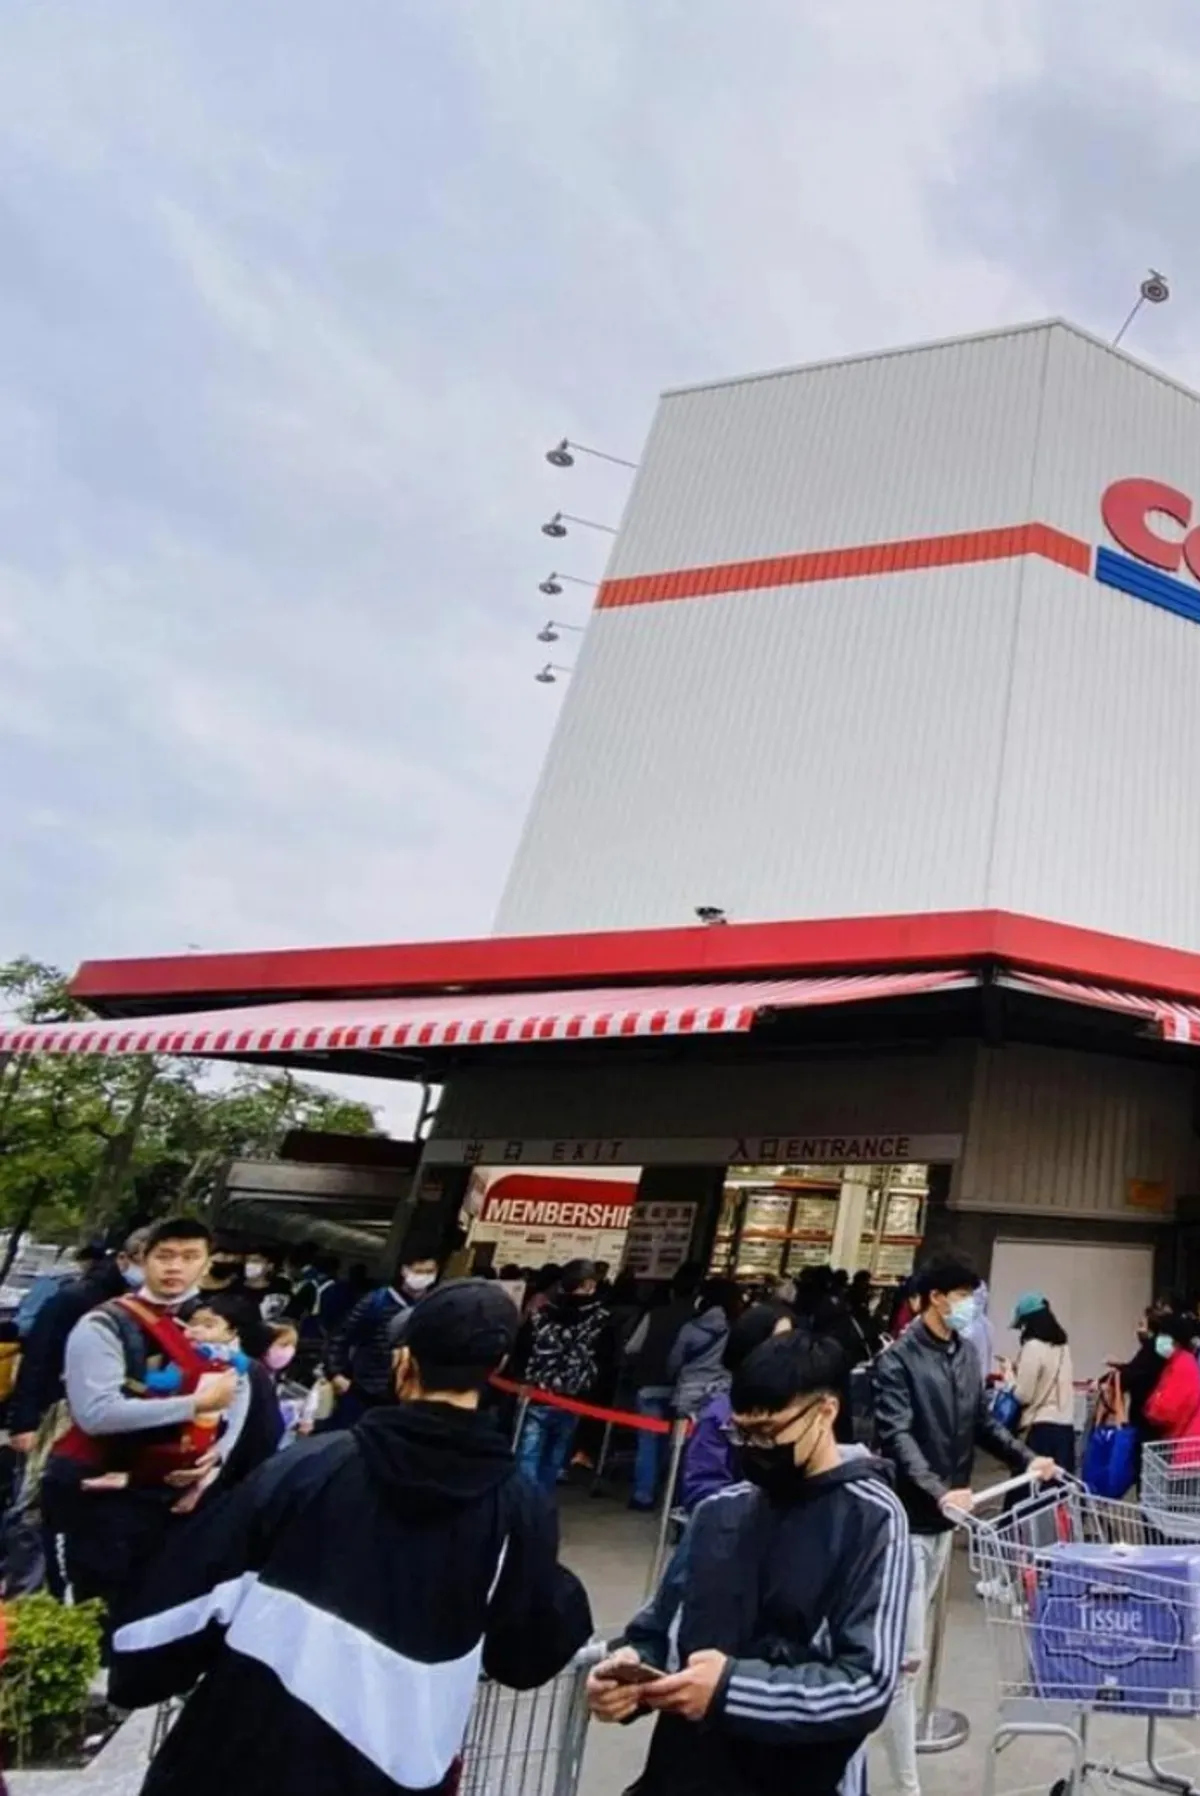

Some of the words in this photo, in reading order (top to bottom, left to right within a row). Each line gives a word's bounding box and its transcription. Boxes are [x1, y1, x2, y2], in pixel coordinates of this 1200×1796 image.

[552, 1140, 623, 1161] EXIT
[729, 1136, 779, 1159] 入口
[786, 1136, 910, 1159] ENTRANCE
[1076, 1602, 1143, 1633] Tissue
